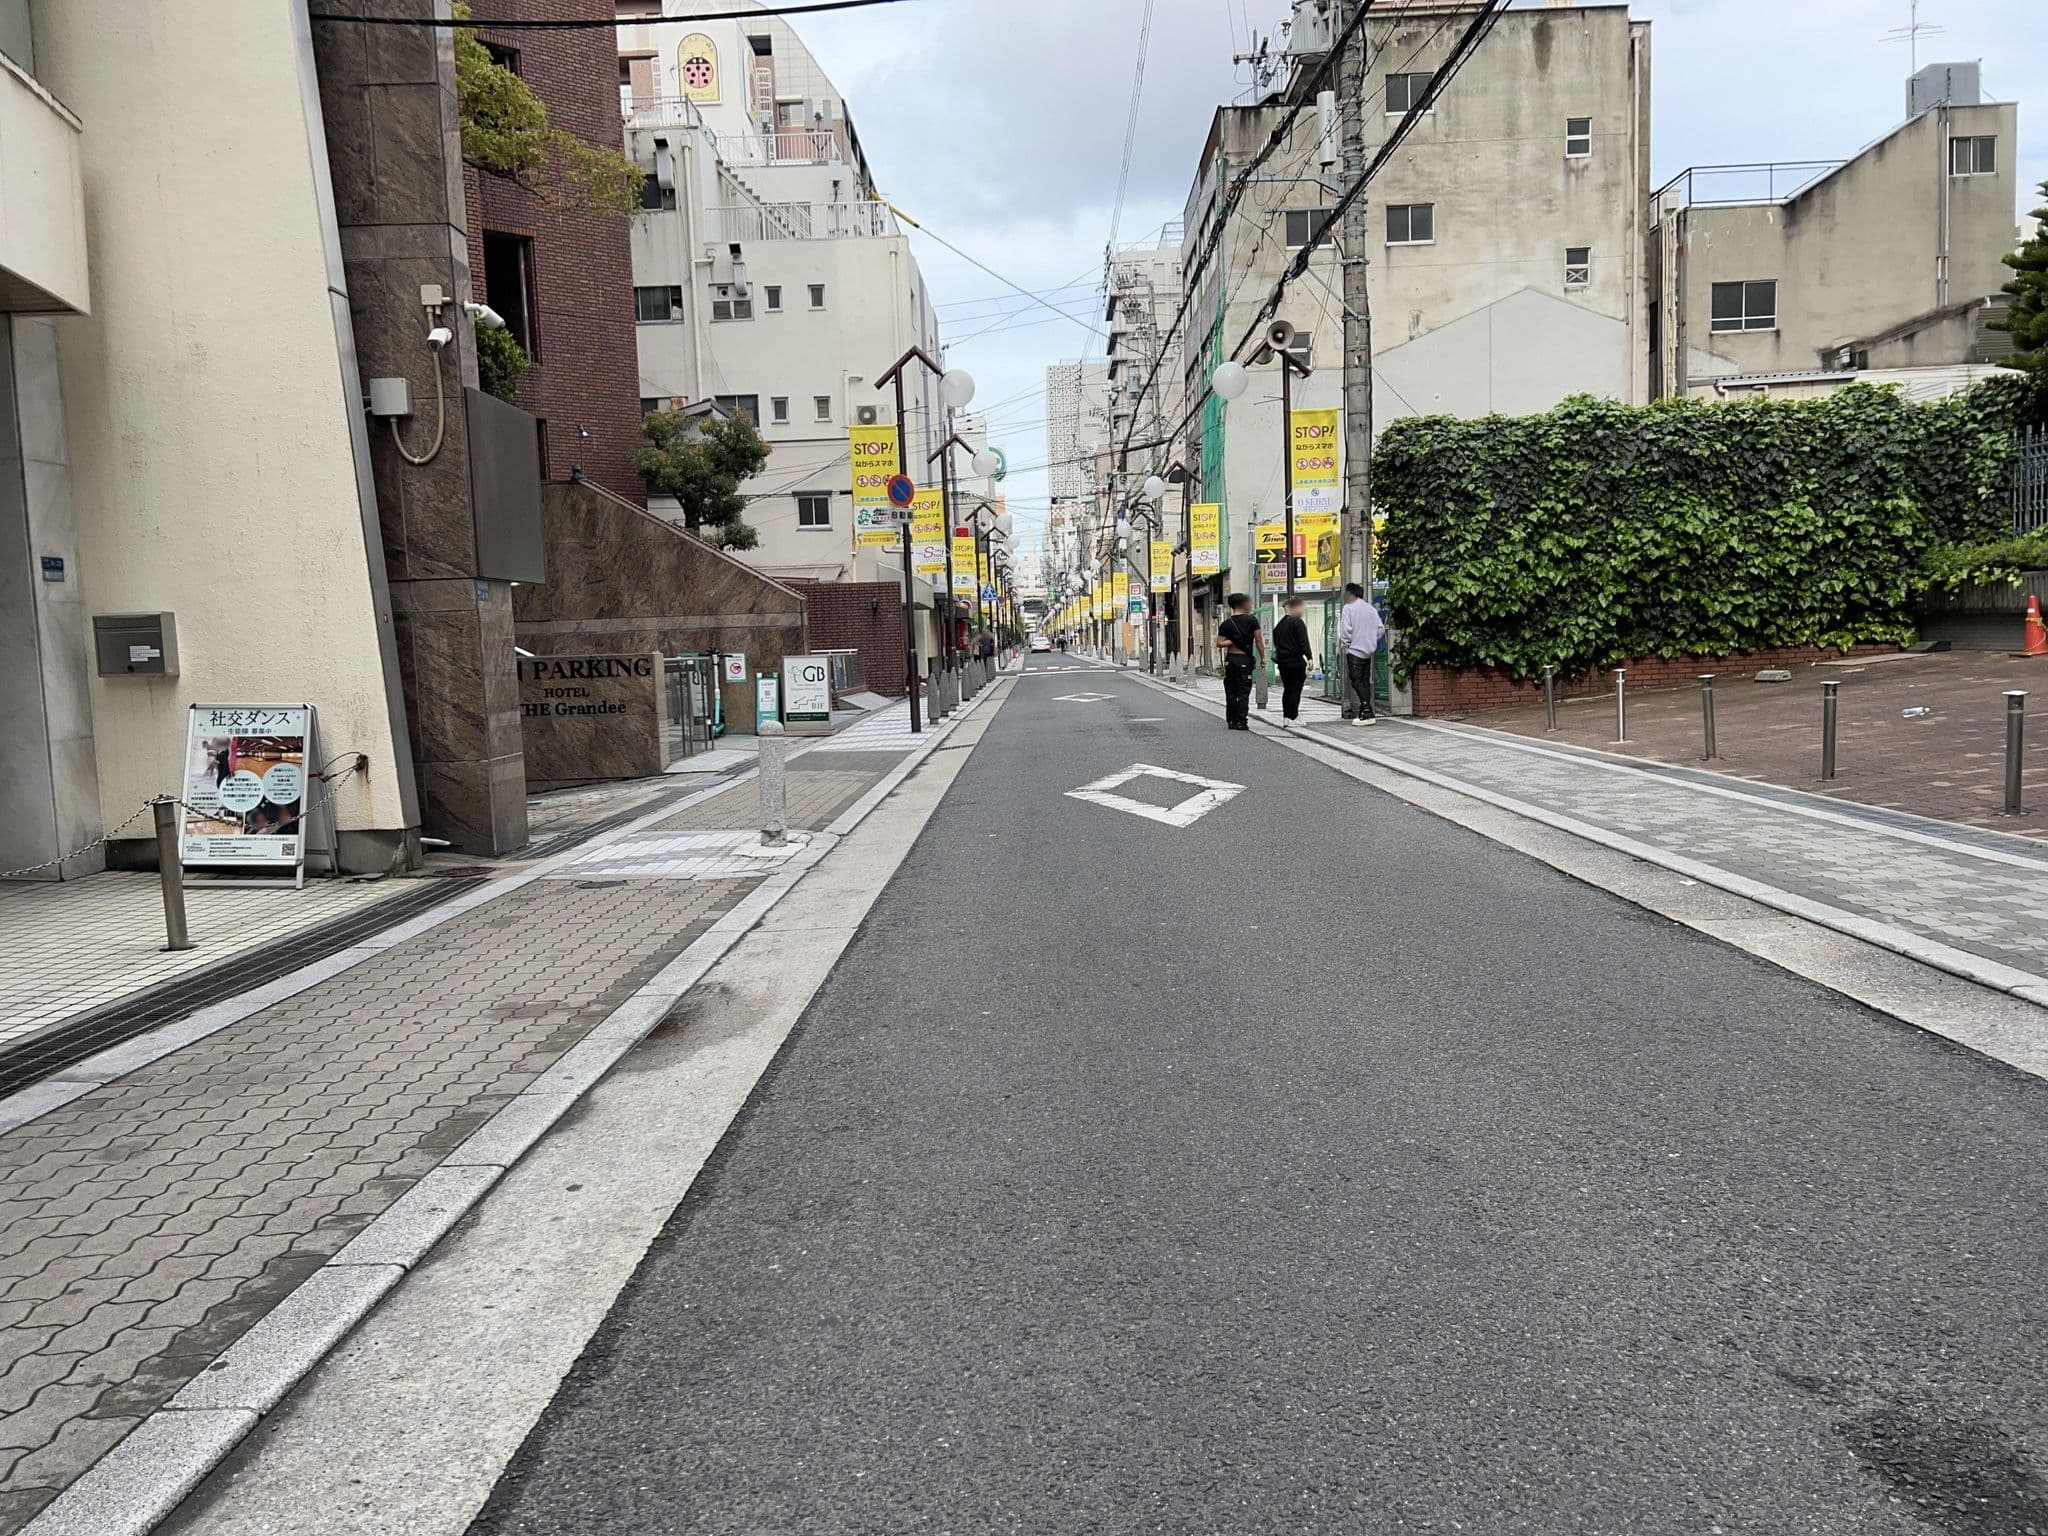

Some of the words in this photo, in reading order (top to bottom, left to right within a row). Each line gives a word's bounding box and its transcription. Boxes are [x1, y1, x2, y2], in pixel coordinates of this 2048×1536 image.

[1295, 425, 1335, 439] STOP!
[854, 442, 894, 455] STOP!
[1295, 442, 1334, 450] ながらスマホ
[855, 459, 895, 467] ながらスマホ
[912, 501, 940, 510] STOP!
[1192, 513, 1217, 521] STOP!
[533, 657, 652, 680] PARKING
[803, 665, 825, 682] GB
[544, 687, 590, 698] HOTEL
[555, 701, 627, 716] Grandee
[210, 710, 291, 727] 社交ダンス
